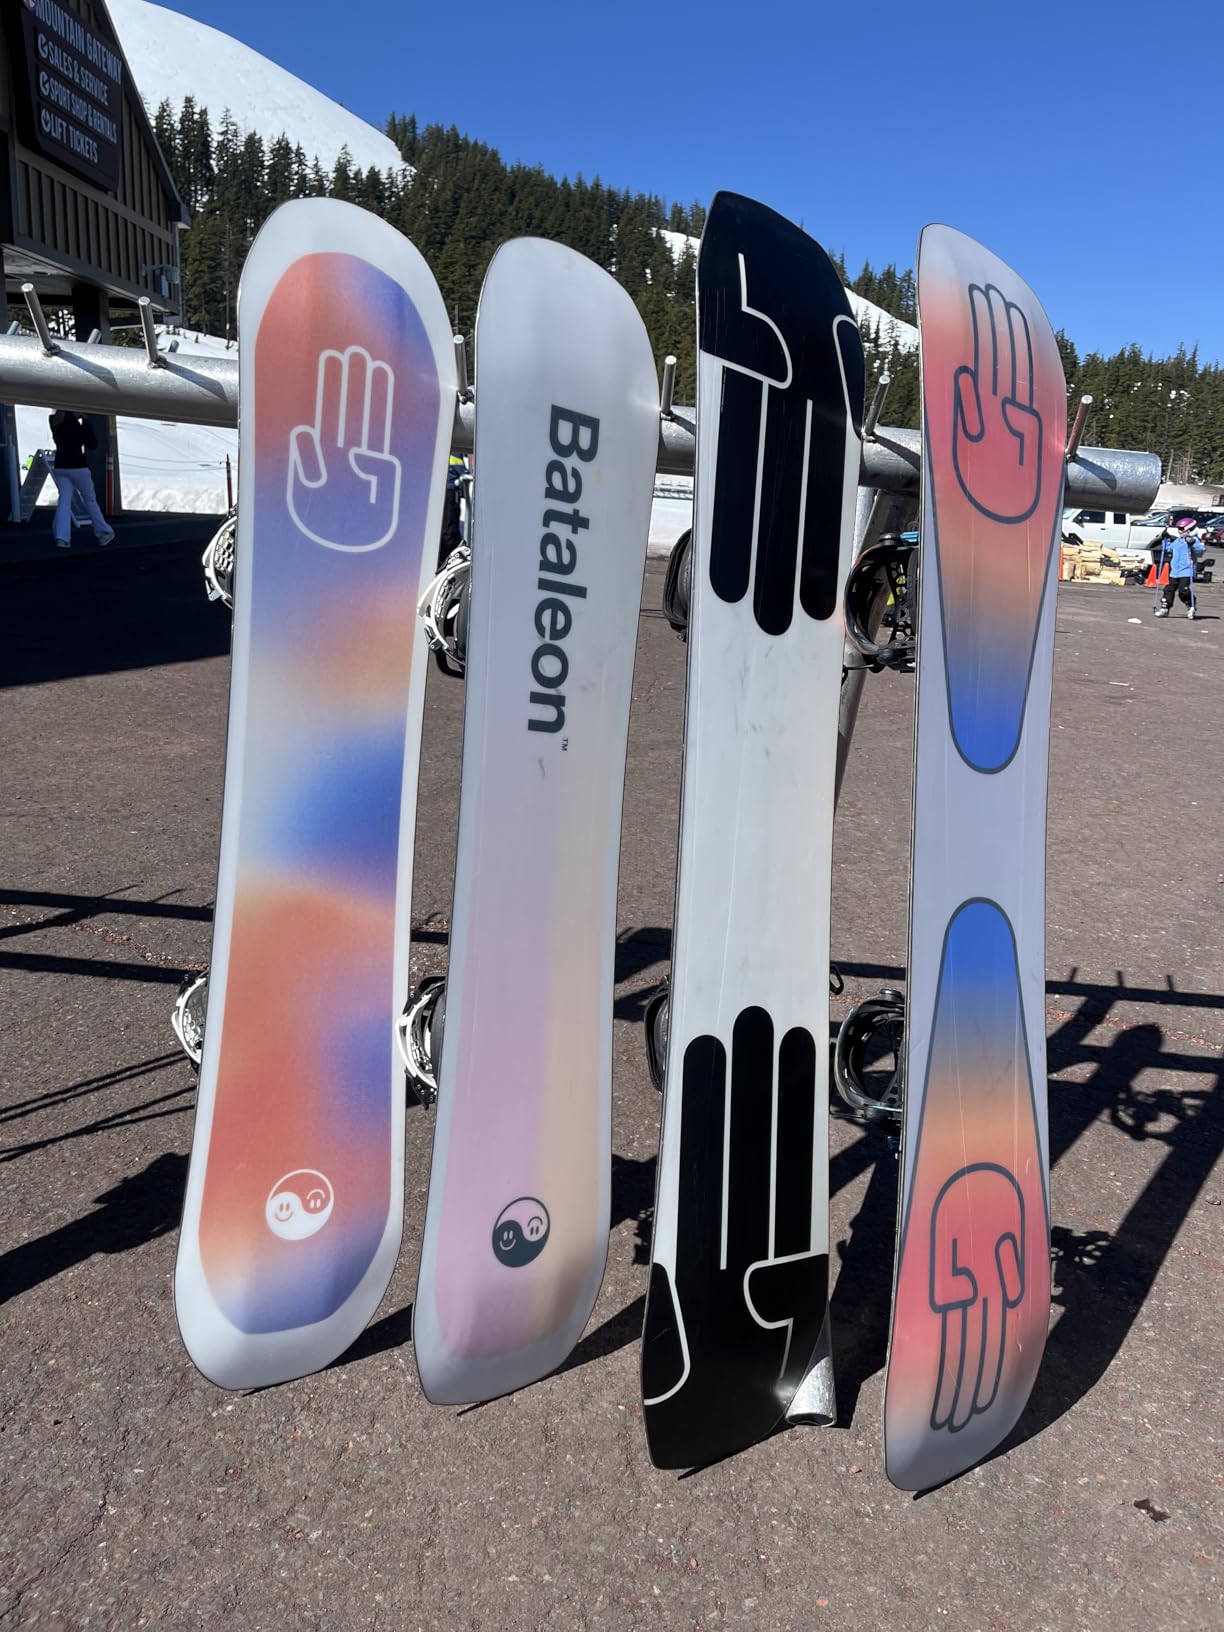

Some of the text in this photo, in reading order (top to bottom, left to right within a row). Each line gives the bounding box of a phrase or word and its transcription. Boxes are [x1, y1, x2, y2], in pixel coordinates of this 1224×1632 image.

[48, 41, 108, 106] SALES & SERVICE
[86, 32, 122, 85] GATEWAY
[50, 77, 71, 112] SPORT
[71, 93, 87, 122] SHOP
[93, 108, 118, 144] RENTALS
[51, 112, 99, 164] LIFT TICKETS
[528, 404, 600, 734] Bataleon
